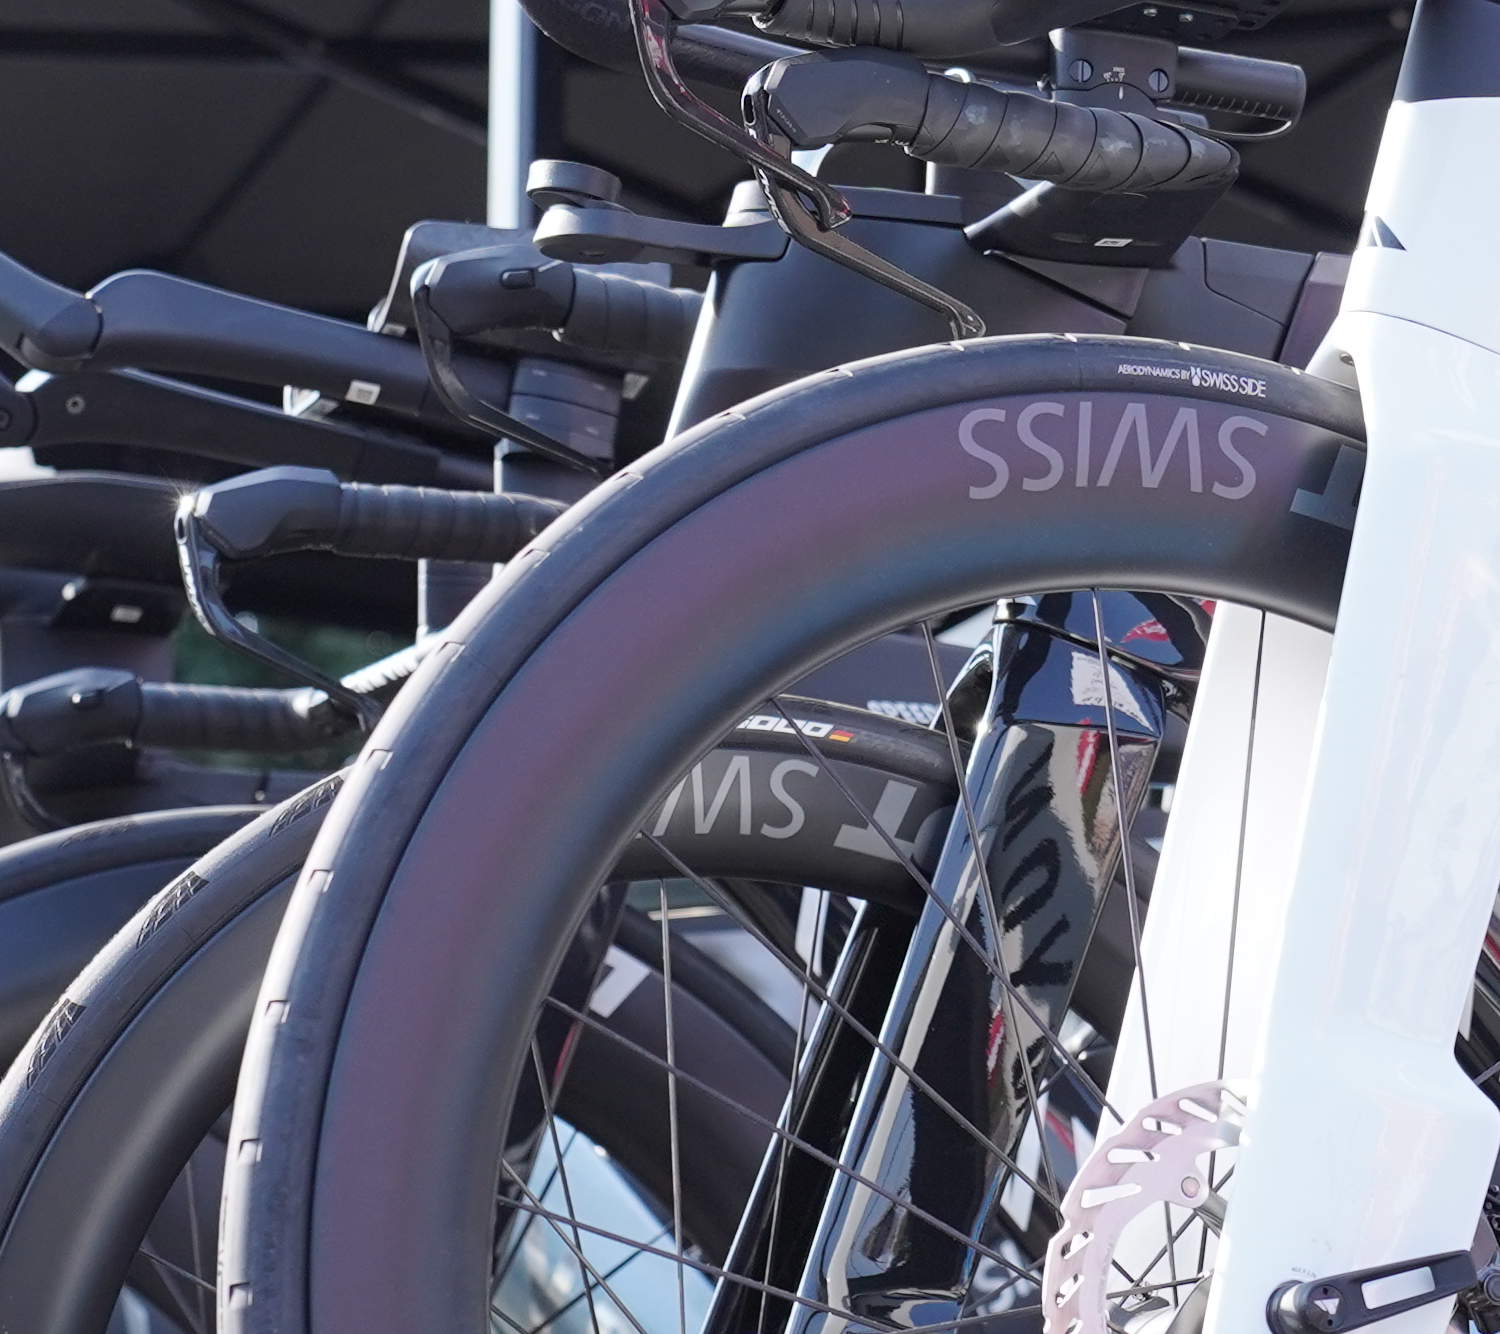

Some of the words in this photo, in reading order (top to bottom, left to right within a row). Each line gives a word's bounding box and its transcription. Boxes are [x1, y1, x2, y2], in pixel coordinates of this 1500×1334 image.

[1201, 370, 1240, 394] SWISS
[1239, 377, 1267, 398] SIDE
[957, 401, 1268, 501] SWISS
[1290, 444, 1368, 530] T
[866, 699, 939, 724] SPEED
